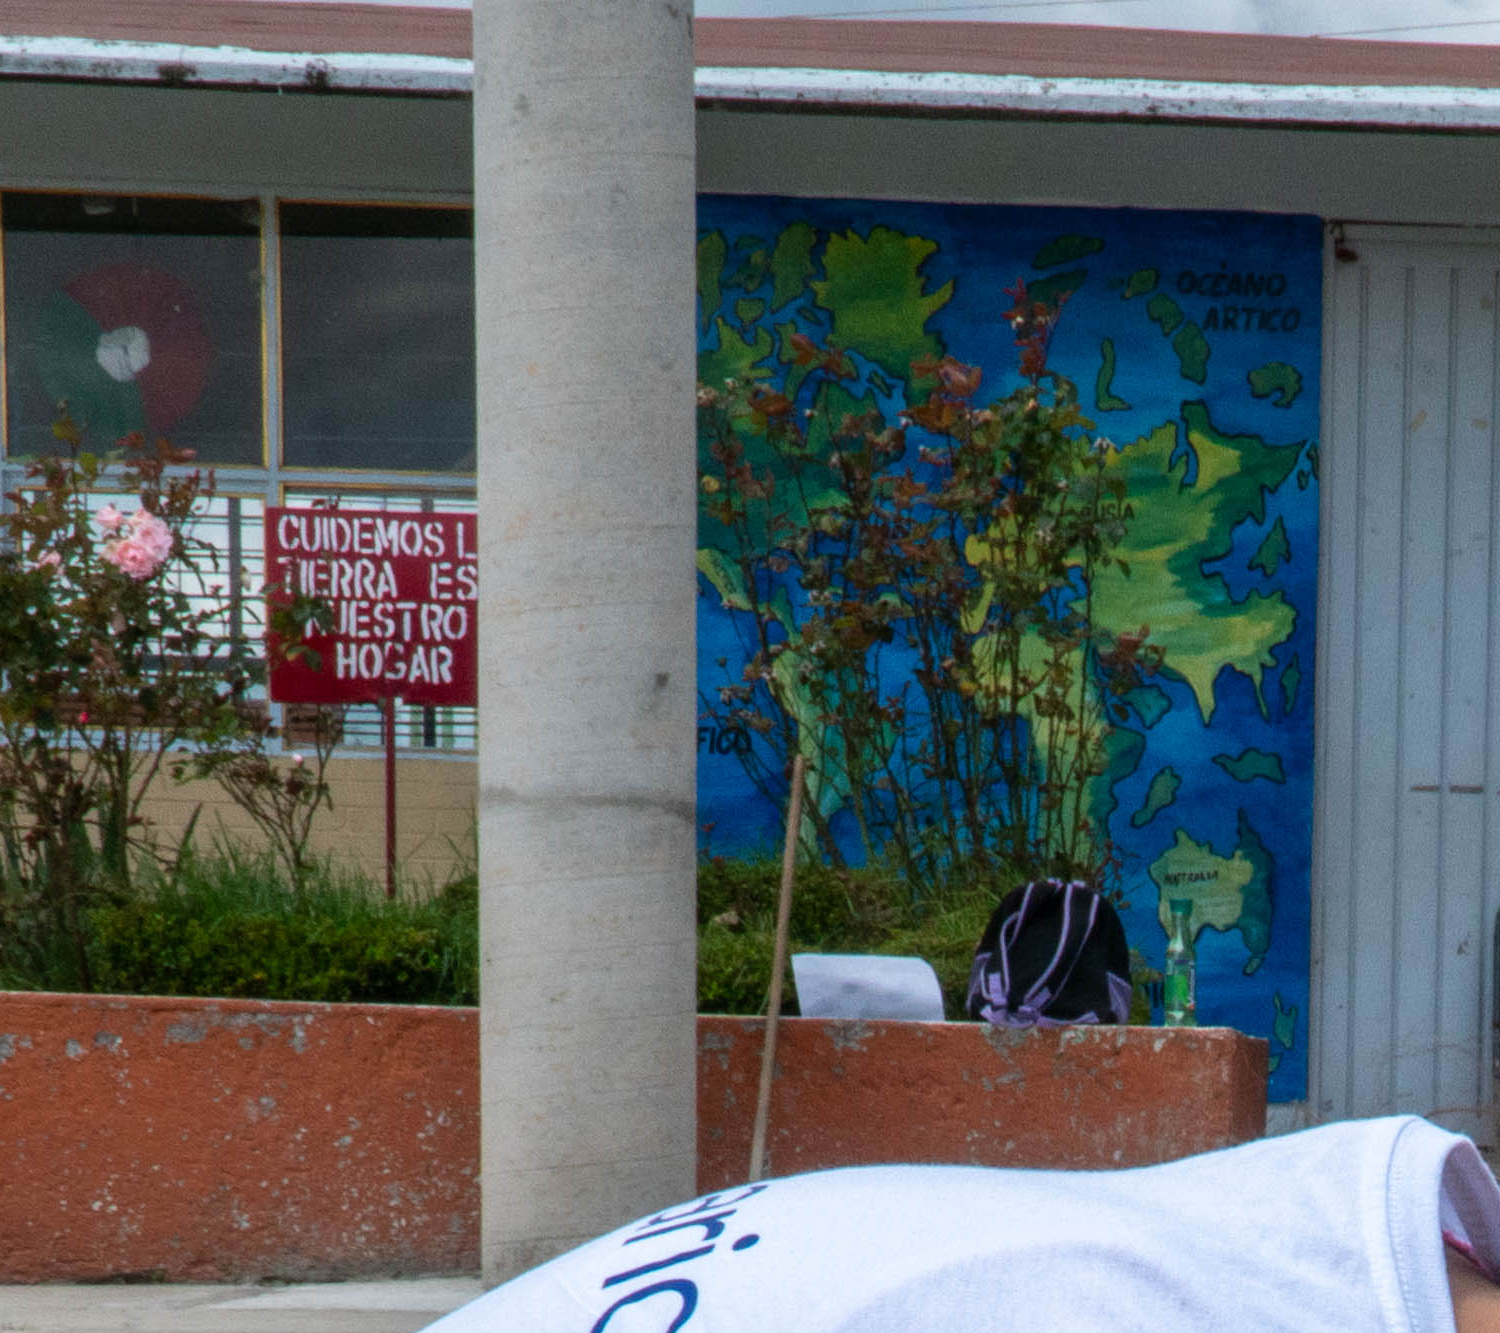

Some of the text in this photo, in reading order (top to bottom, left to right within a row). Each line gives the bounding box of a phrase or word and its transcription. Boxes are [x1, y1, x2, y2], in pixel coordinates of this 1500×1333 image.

[277, 514, 445, 558] CUIDEMOS
[277, 556, 478, 601] TIERRA ES
[335, 642, 454, 685] HOGAR
